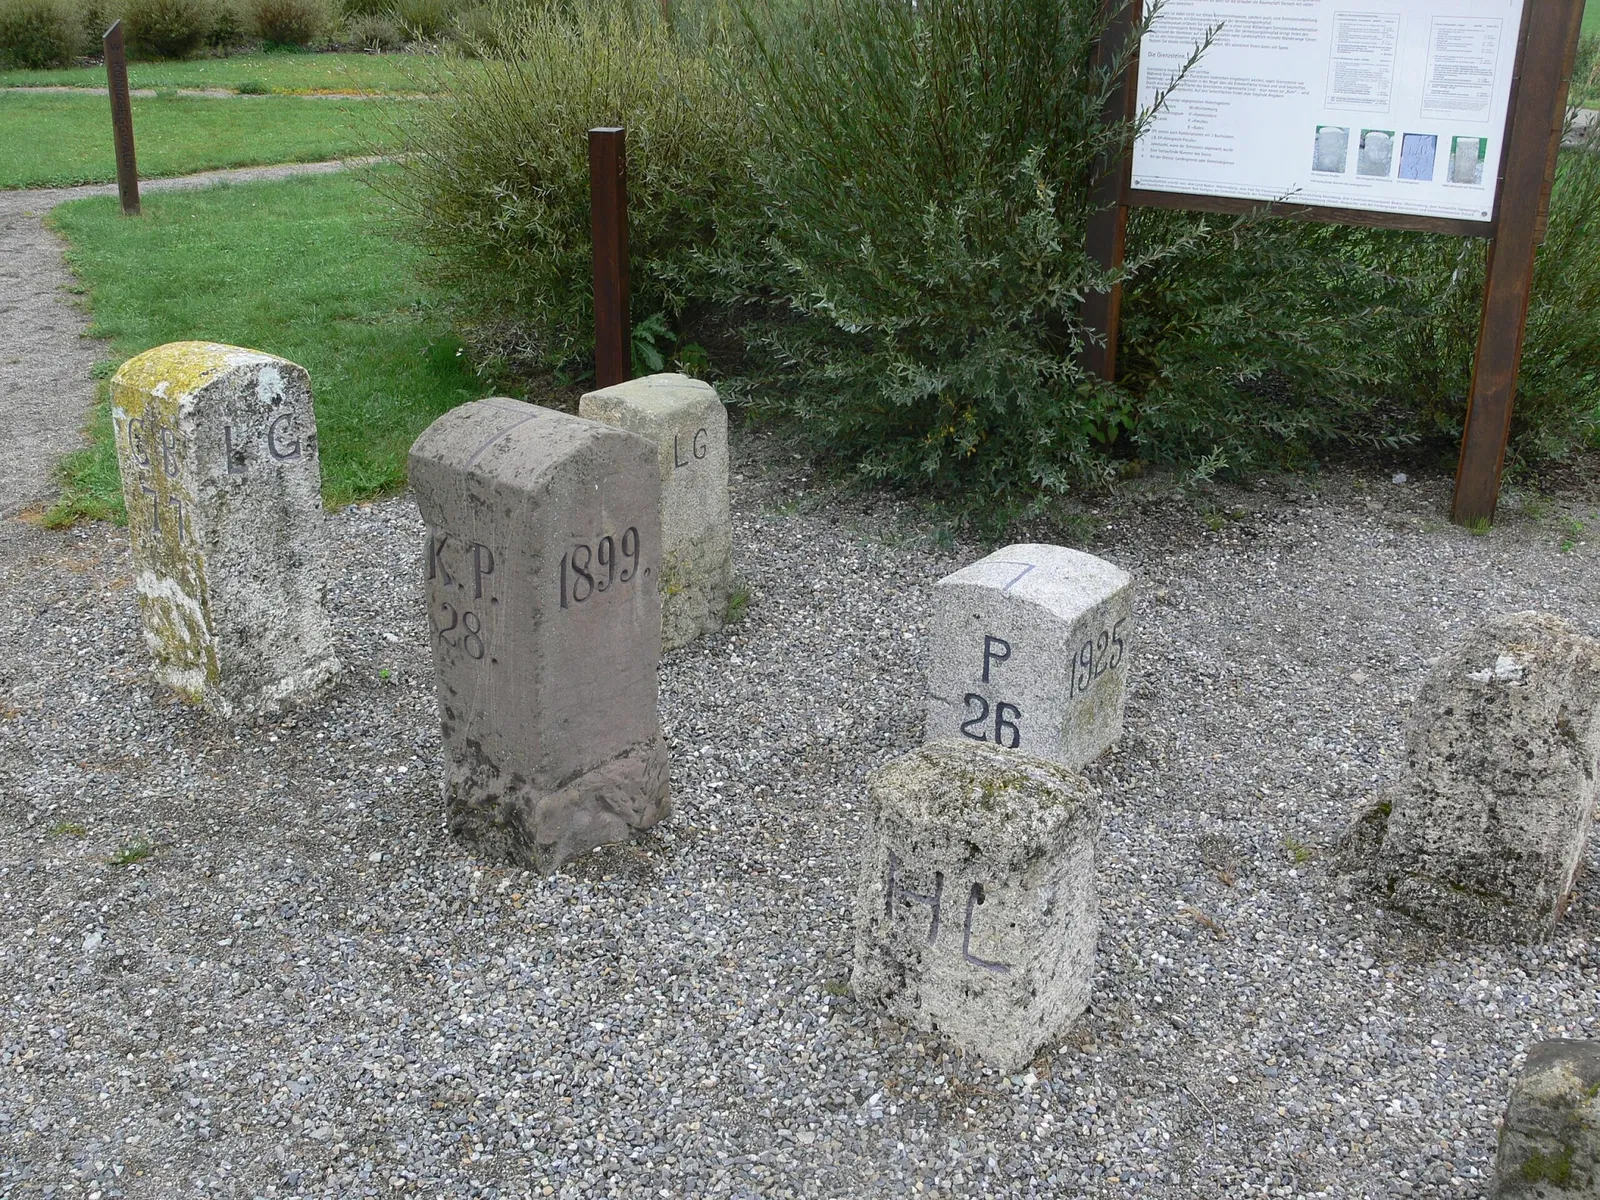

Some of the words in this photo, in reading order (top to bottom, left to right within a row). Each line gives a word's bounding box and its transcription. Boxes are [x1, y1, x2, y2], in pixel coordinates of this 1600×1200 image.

[673, 427, 708, 469] LG
[142, 485, 185, 542] 77
[981, 634, 1012, 684] P
[1069, 617, 1126, 701] 1925
[959, 692, 1022, 750] 26
